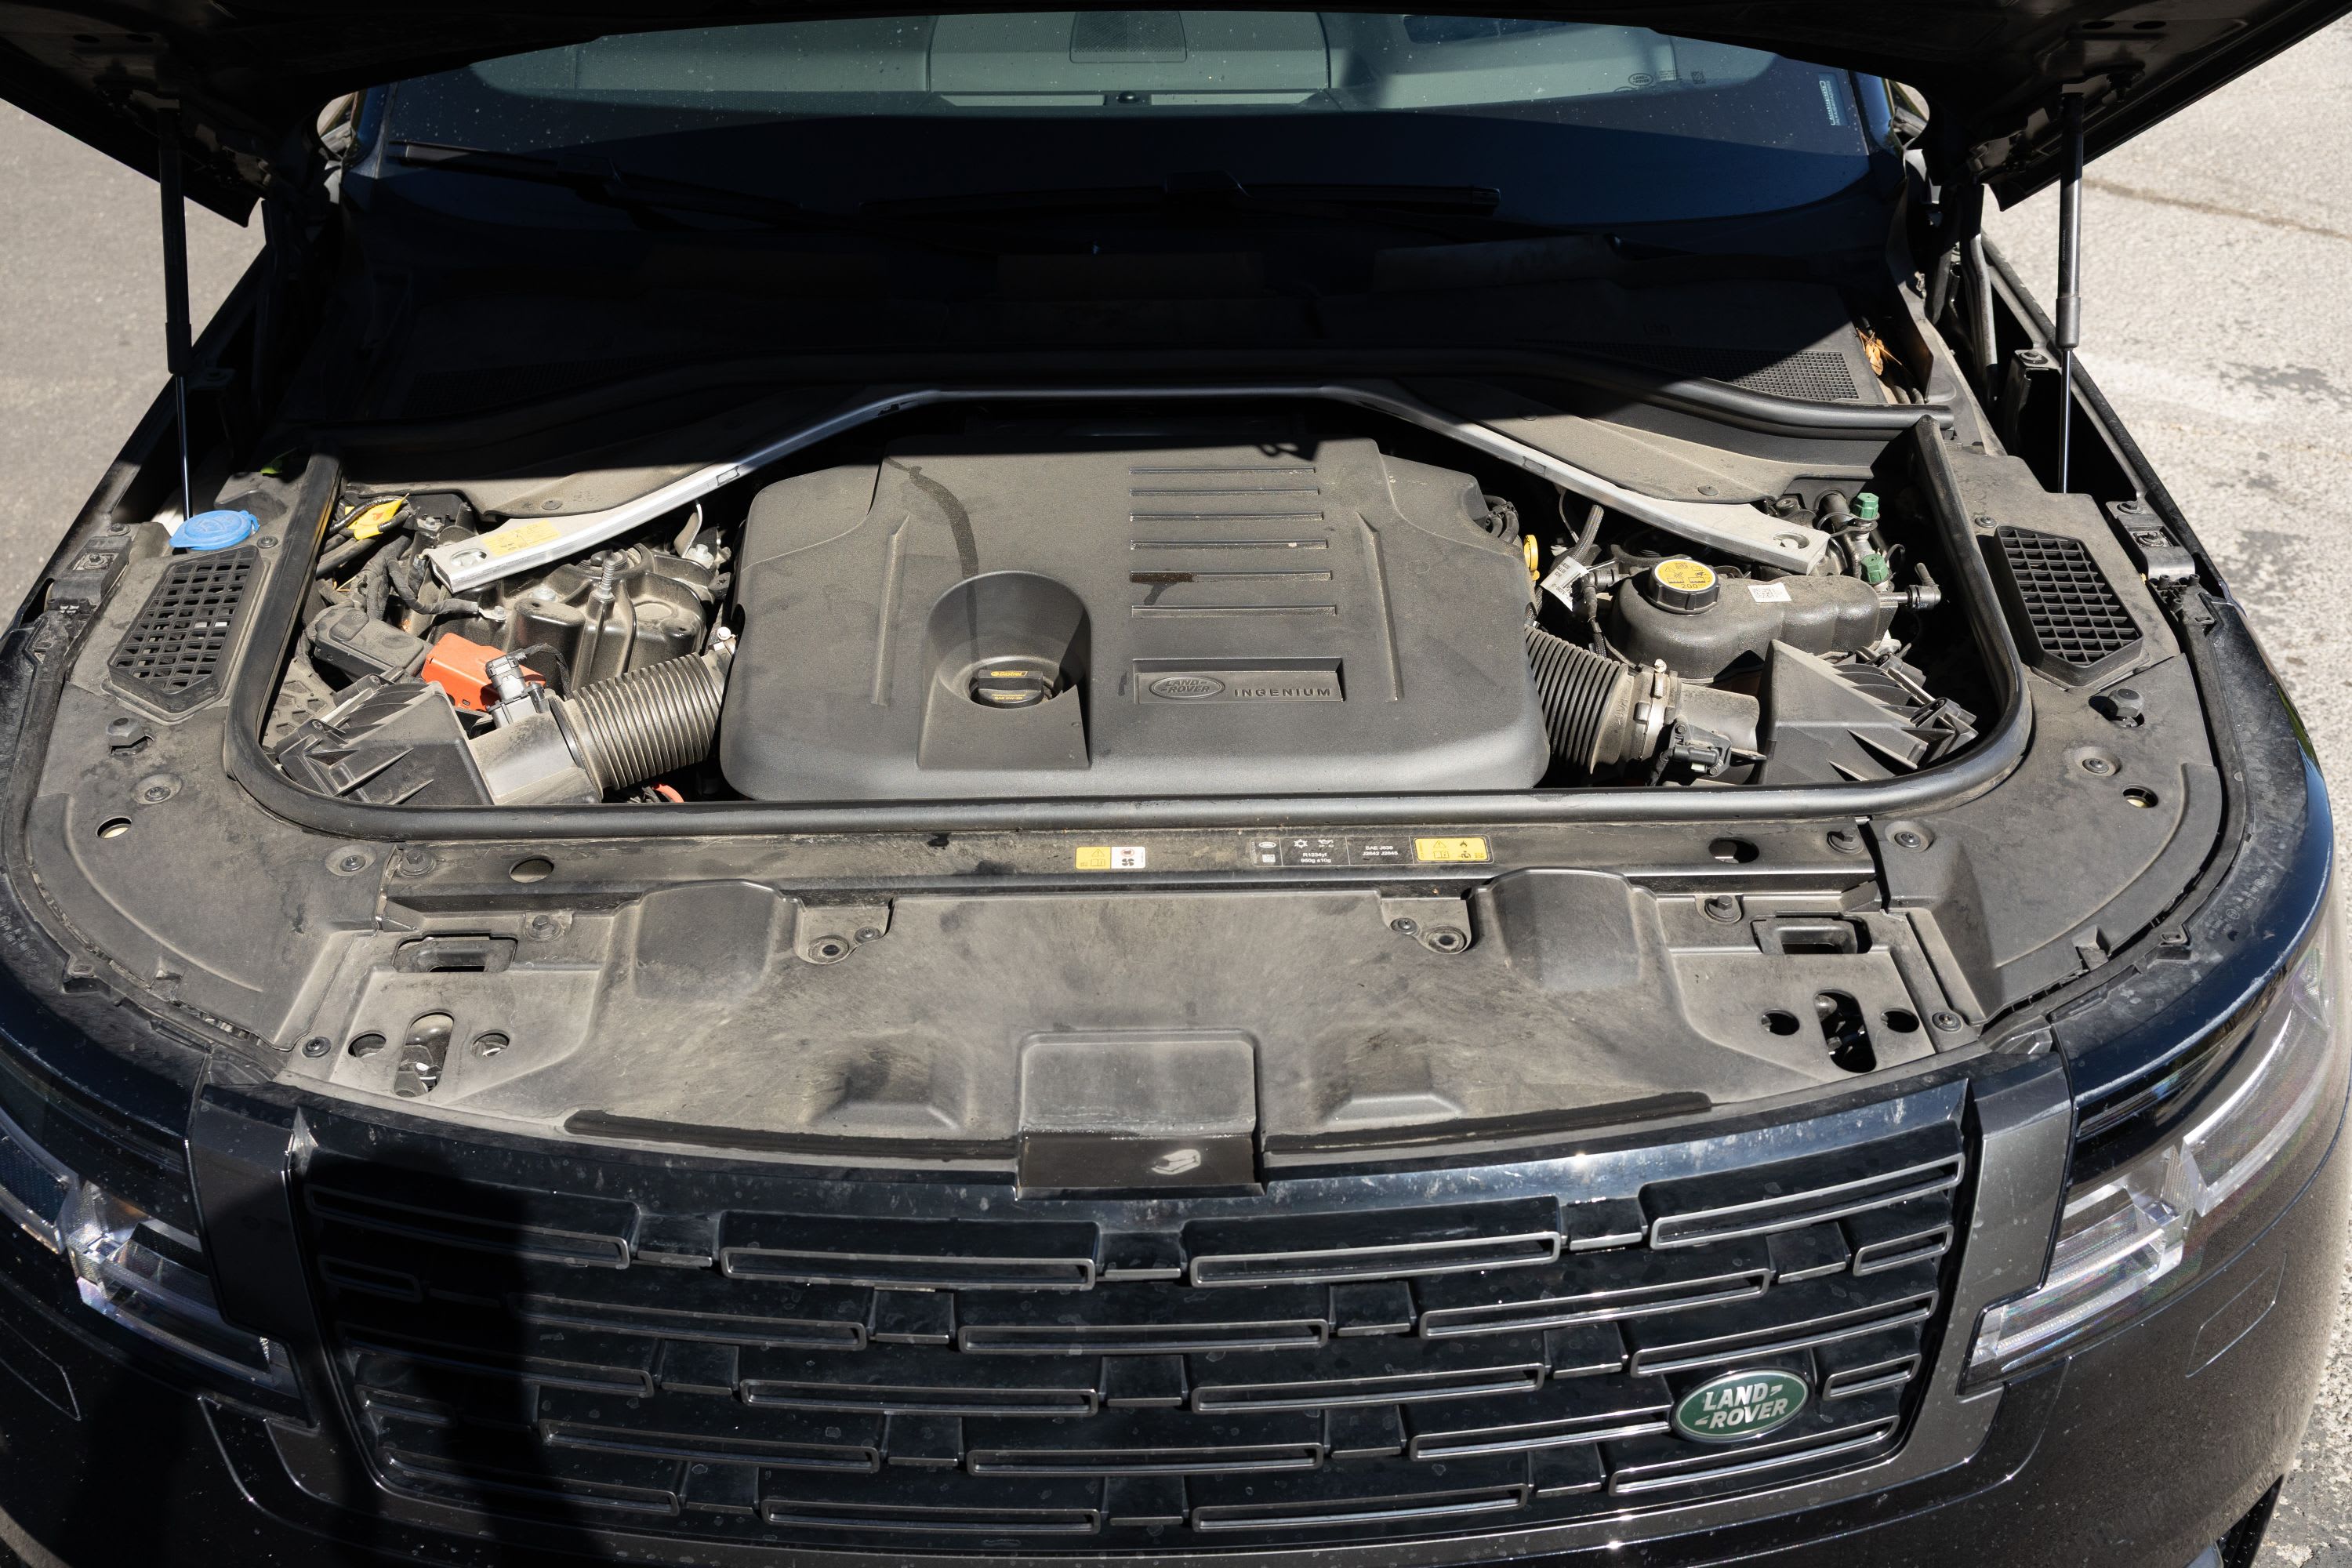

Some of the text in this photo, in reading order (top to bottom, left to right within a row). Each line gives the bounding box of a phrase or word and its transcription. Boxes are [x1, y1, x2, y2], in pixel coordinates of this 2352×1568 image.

[1166, 678, 1201, 687] LAND
[1168, 684, 1210, 694] ROVER
[1234, 688, 1331, 698] INGENIUM
[1703, 1382, 1769, 1412] LAND
[1708, 1398, 1788, 1429] ROVER
